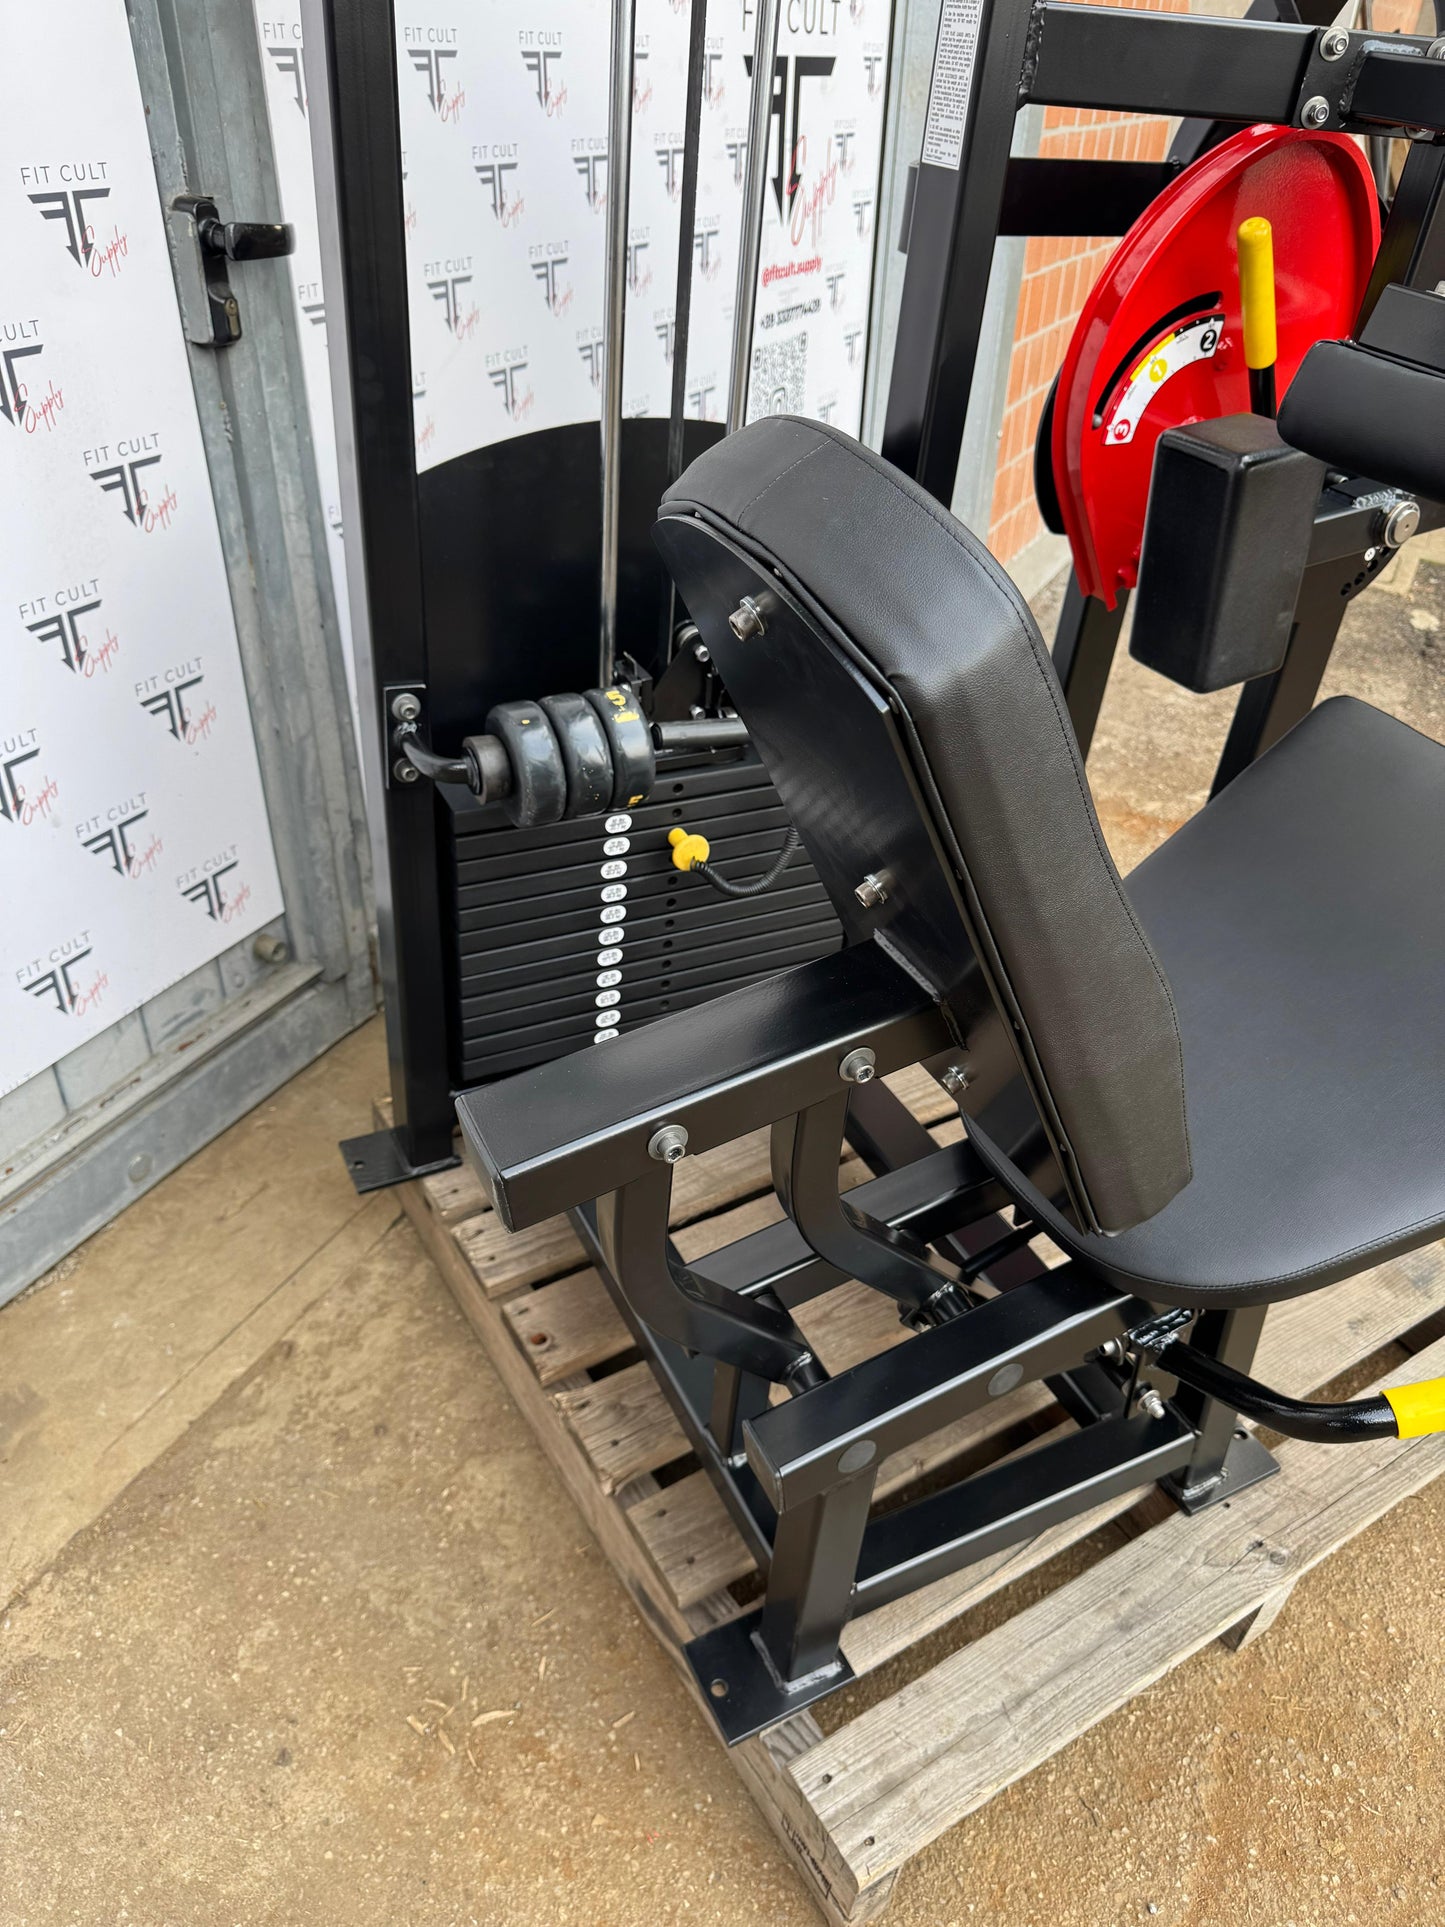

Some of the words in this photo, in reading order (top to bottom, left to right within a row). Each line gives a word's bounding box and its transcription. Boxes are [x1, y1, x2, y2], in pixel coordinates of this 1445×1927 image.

[263, 23, 285, 39] FIT
[404, 27, 422, 43] FIT
[427, 28, 457, 43] CULT
[787, 0, 840, 35] CULT
[519, 30, 534, 45] FIT
[538, 31, 562, 46] CULT
[472, 145, 488, 160] FIT
[492, 143, 518, 158] CULT
[571, 138, 585, 152] FIT
[668, 131, 684, 145] CUL
[20, 166, 50, 185] FIT
[60, 162, 107, 182] CULT
[786, 135, 838, 247] Supply
[81, 224, 128, 278] Supply
[424, 262, 441, 276] FIT
[445, 256, 473, 273] CULT
[528, 245, 544, 258] FIT
[546, 240, 569, 256] CULT
[298, 283, 319, 300] FIT
[485, 353, 501, 367] FIT
[504, 345, 528, 363] CULT
[14, 379, 64, 434] Supply
[83, 446, 109, 466] FIT
[117, 432, 159, 457] CULT
[136, 484, 177, 533] Supply
[18, 597, 47, 620] FIT
[54, 578, 100, 606] CULT
[75, 628, 119, 678] Supply
[134, 676, 158, 697] FIT
[164, 656, 204, 683] CULT
[179, 701, 217, 745] Supply
[12, 775, 59, 826] Supply
[75, 816, 100, 839] FIT
[107, 792, 147, 822] CULT
[124, 833, 163, 879] Supply
[175, 868, 198, 889] FIT
[203, 844, 238, 872] CULT
[16, 960, 42, 983] FIT
[49, 930, 91, 963] CULT
